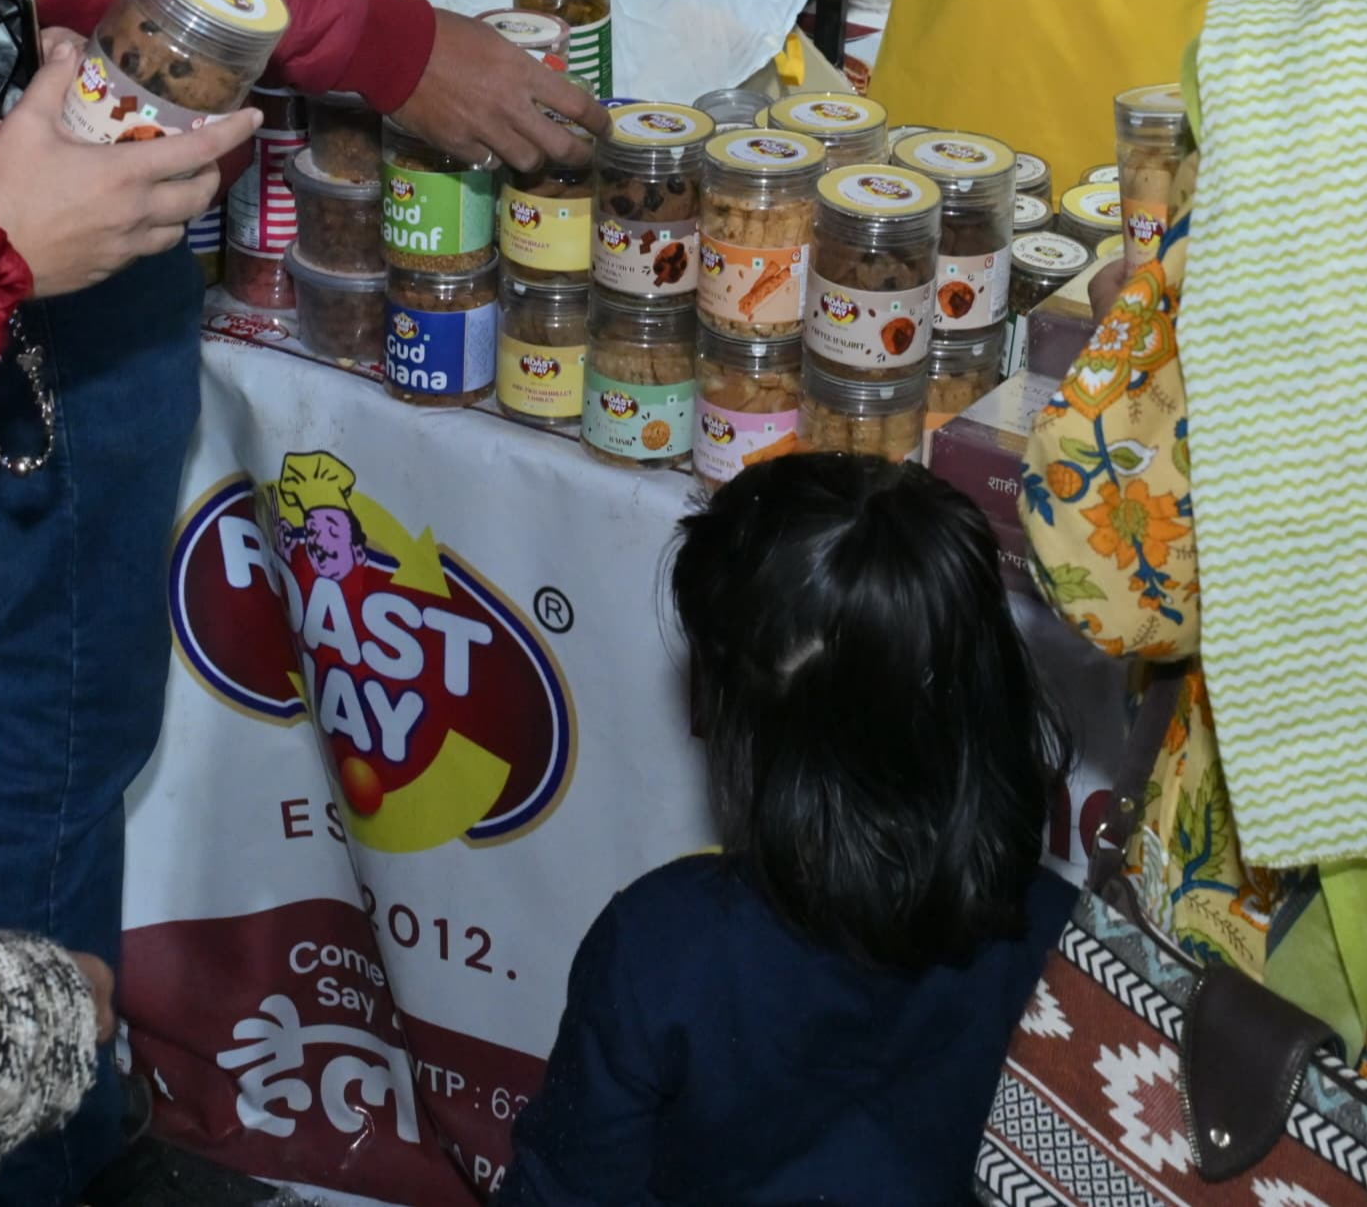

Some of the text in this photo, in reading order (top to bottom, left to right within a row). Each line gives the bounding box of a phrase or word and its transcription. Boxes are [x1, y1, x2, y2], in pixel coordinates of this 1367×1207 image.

[383, 197, 421, 225] Gud
[380, 226, 444, 252] aunf
[823, 294, 854, 310] ROAST
[387, 334, 426, 364] Gud
[987, 475, 1018, 496] शाही
[289, 940, 385, 987] Come
[317, 976, 375, 1023] Say
